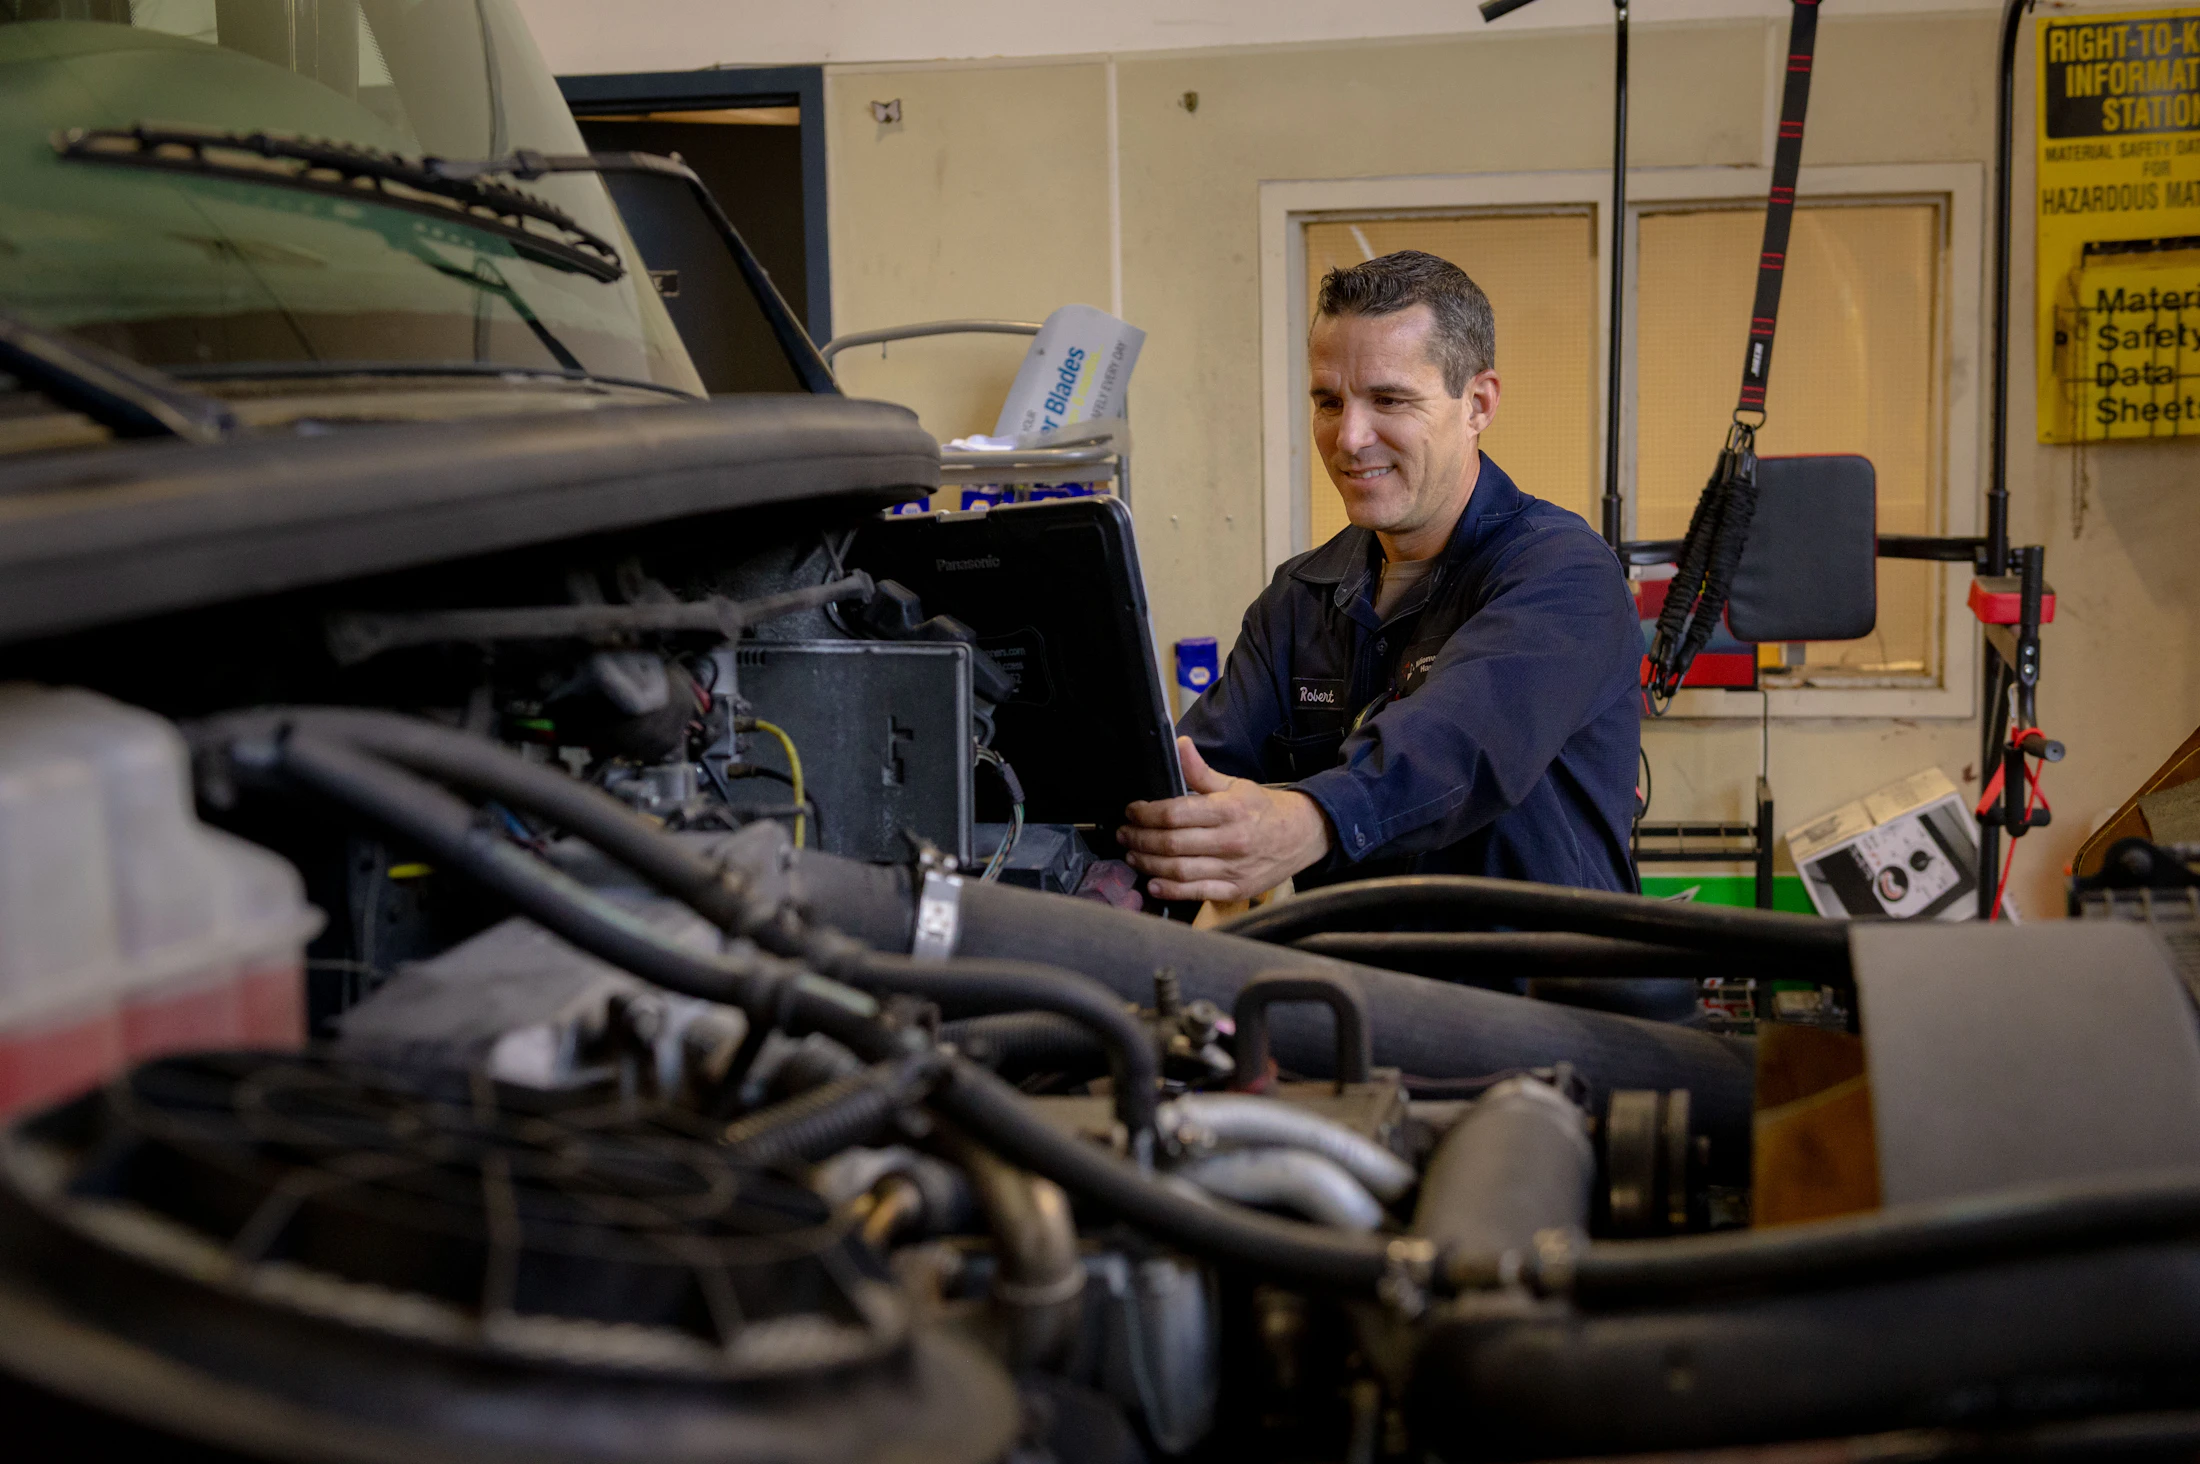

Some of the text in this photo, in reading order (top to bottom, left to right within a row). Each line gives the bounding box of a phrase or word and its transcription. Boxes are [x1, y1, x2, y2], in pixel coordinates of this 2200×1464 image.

[2050, 21, 2200, 62] RIGHT-TO-K
[2065, 57, 2200, 98] INFORMAT
[2045, 143, 2112, 162] MATERIAL
[2119, 140, 2171, 159] SAFETY
[2142, 160, 2171, 178] FOR
[2042, 182, 2159, 215] HAZARDOUS
[1101, 361, 1120, 392] EVERY
[1113, 339, 1128, 361] DAY
[2096, 361, 2174, 388] Data
[1044, 346, 1086, 416] Blades
[2096, 396, 2200, 425] Sheet
[936, 554, 1000, 572] Panasonic
[1300, 686, 1335, 704] Robert
